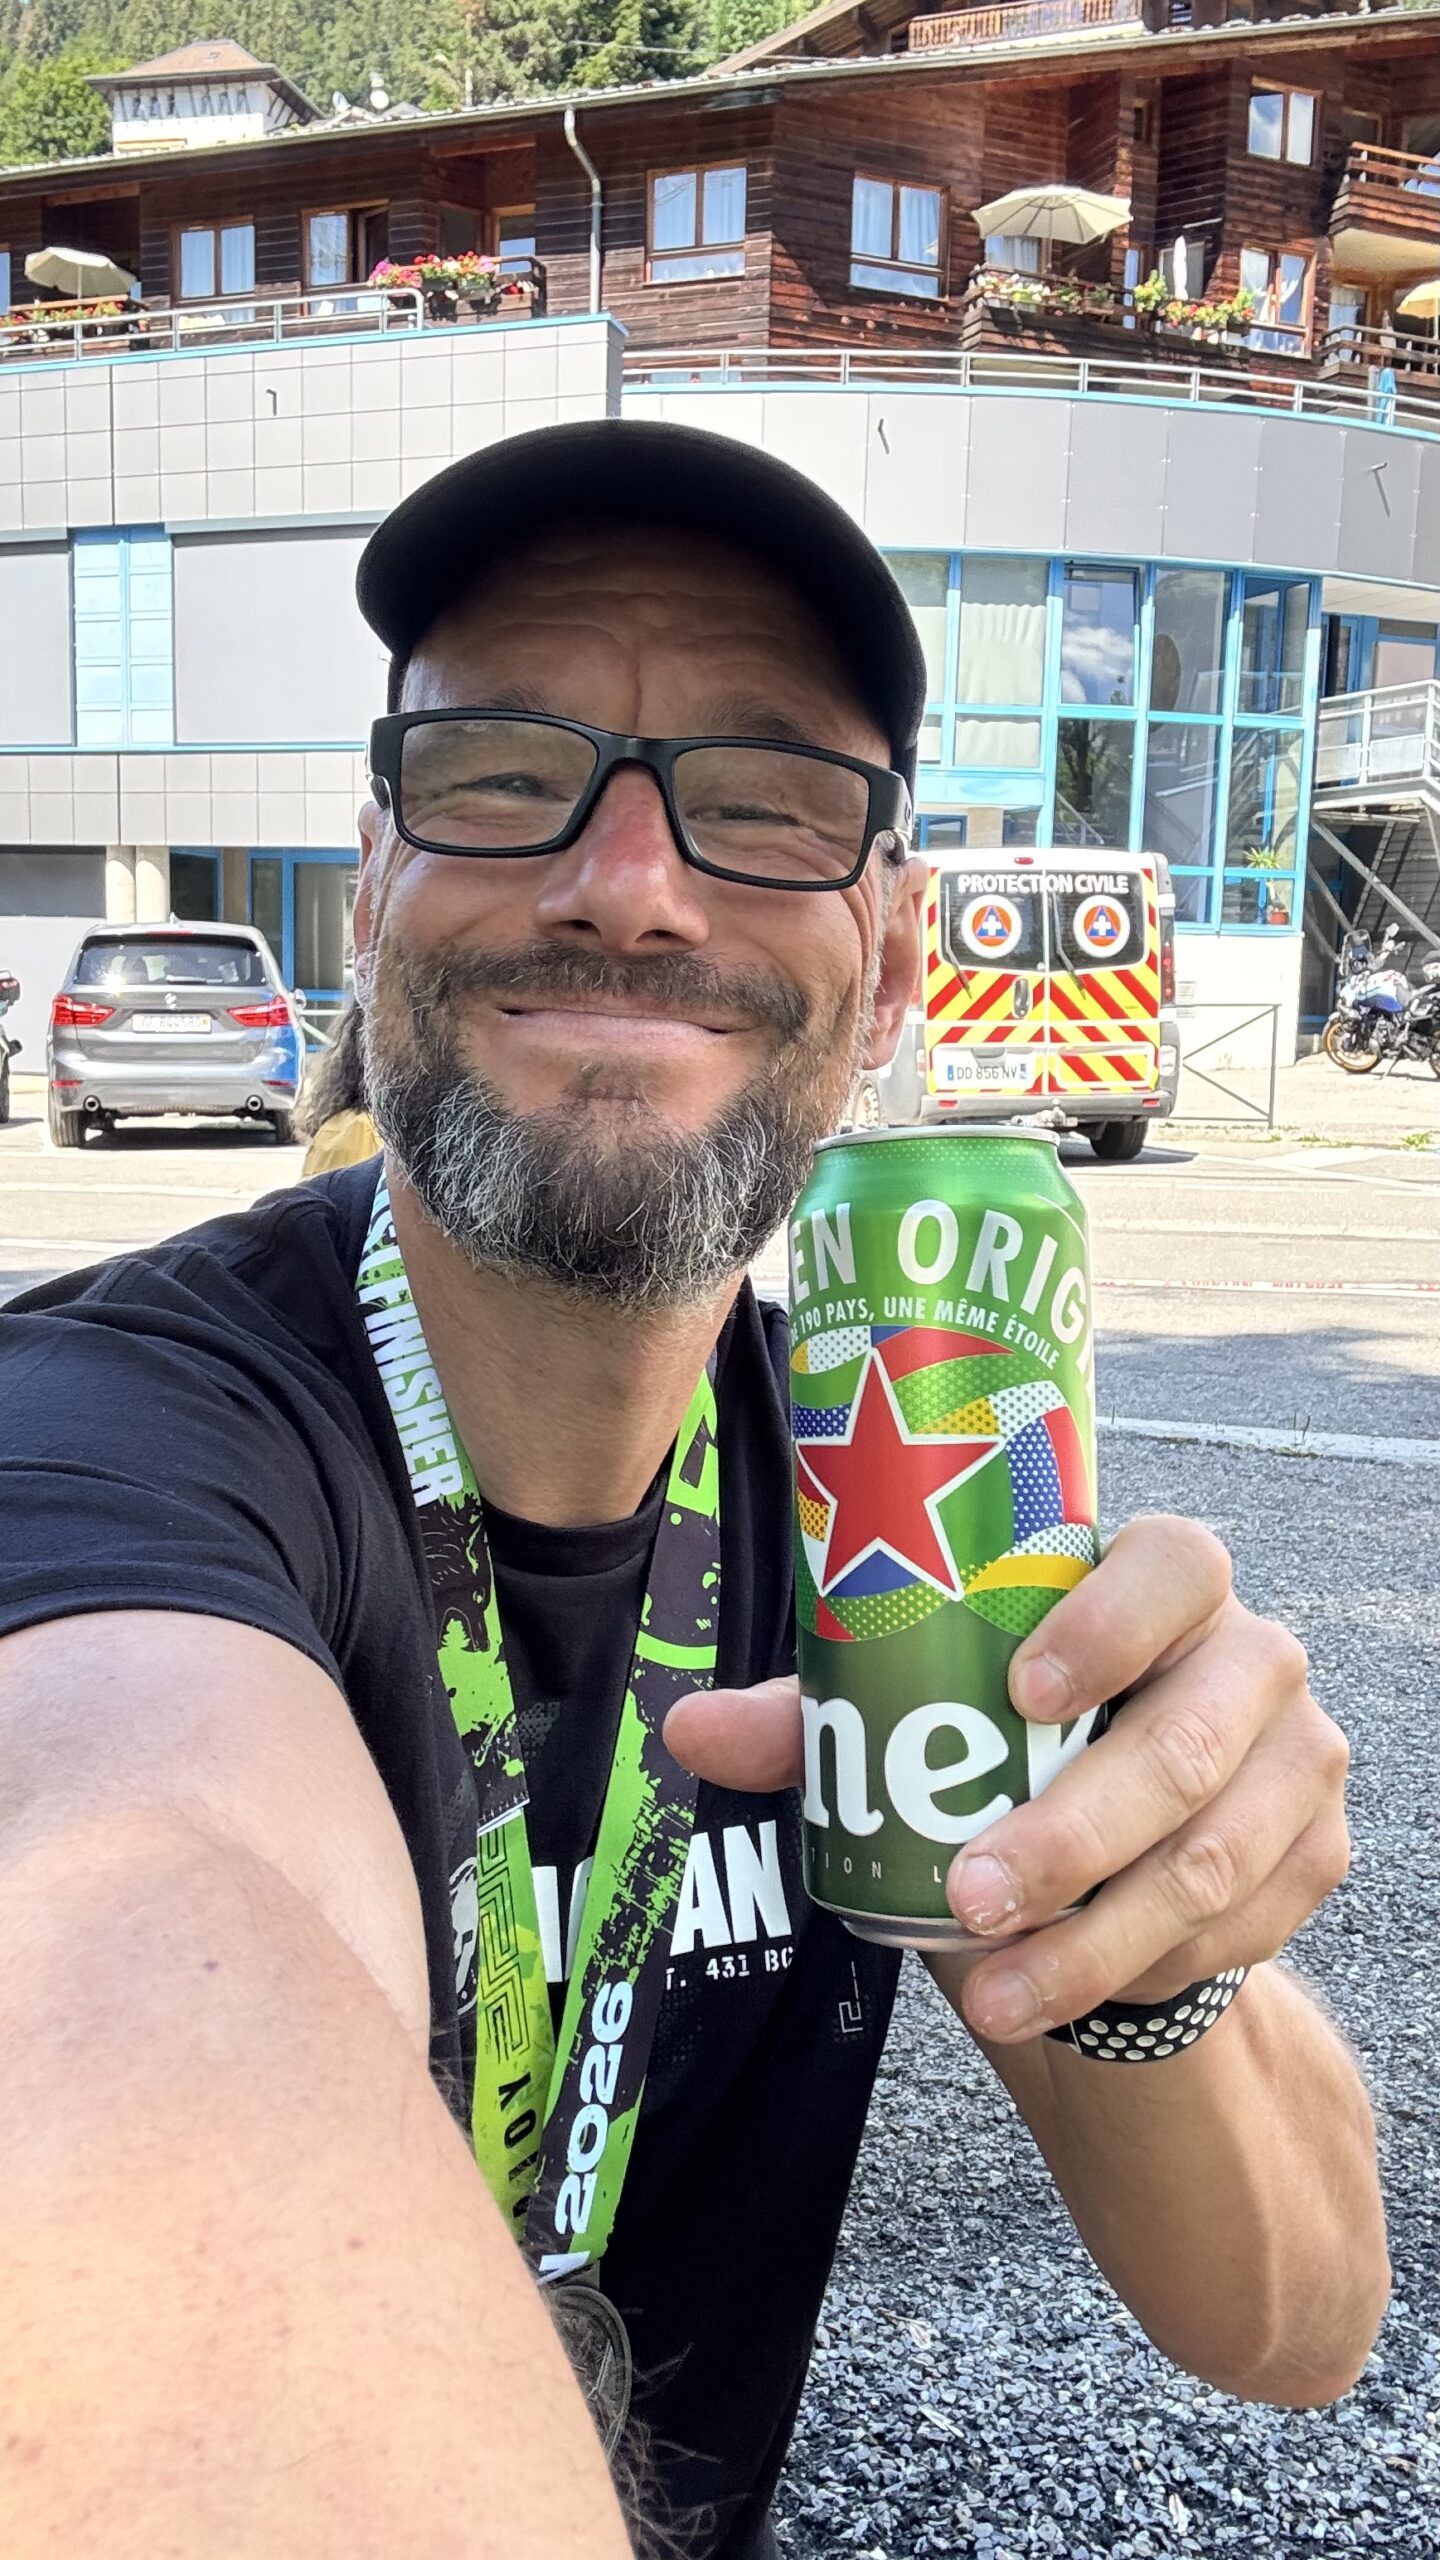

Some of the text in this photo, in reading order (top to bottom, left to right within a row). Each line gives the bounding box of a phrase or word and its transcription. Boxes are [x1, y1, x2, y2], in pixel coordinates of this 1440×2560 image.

[958, 874, 1130, 895] PROTECTION CIVILE
[789, 1202, 857, 1306] EN
[799, 1306, 822, 1334] 190
[825, 1298, 875, 1324] PAYS,
[883, 1296, 927, 1319] UNE
[933, 1297, 1000, 1334] MÊME
[1002, 1313, 1060, 1370] ÉTOILE
[359, 1274, 466, 1508] FINISHER
[764, 1946, 794, 1973] BC
[554, 1981, 634, 2235] 2026
